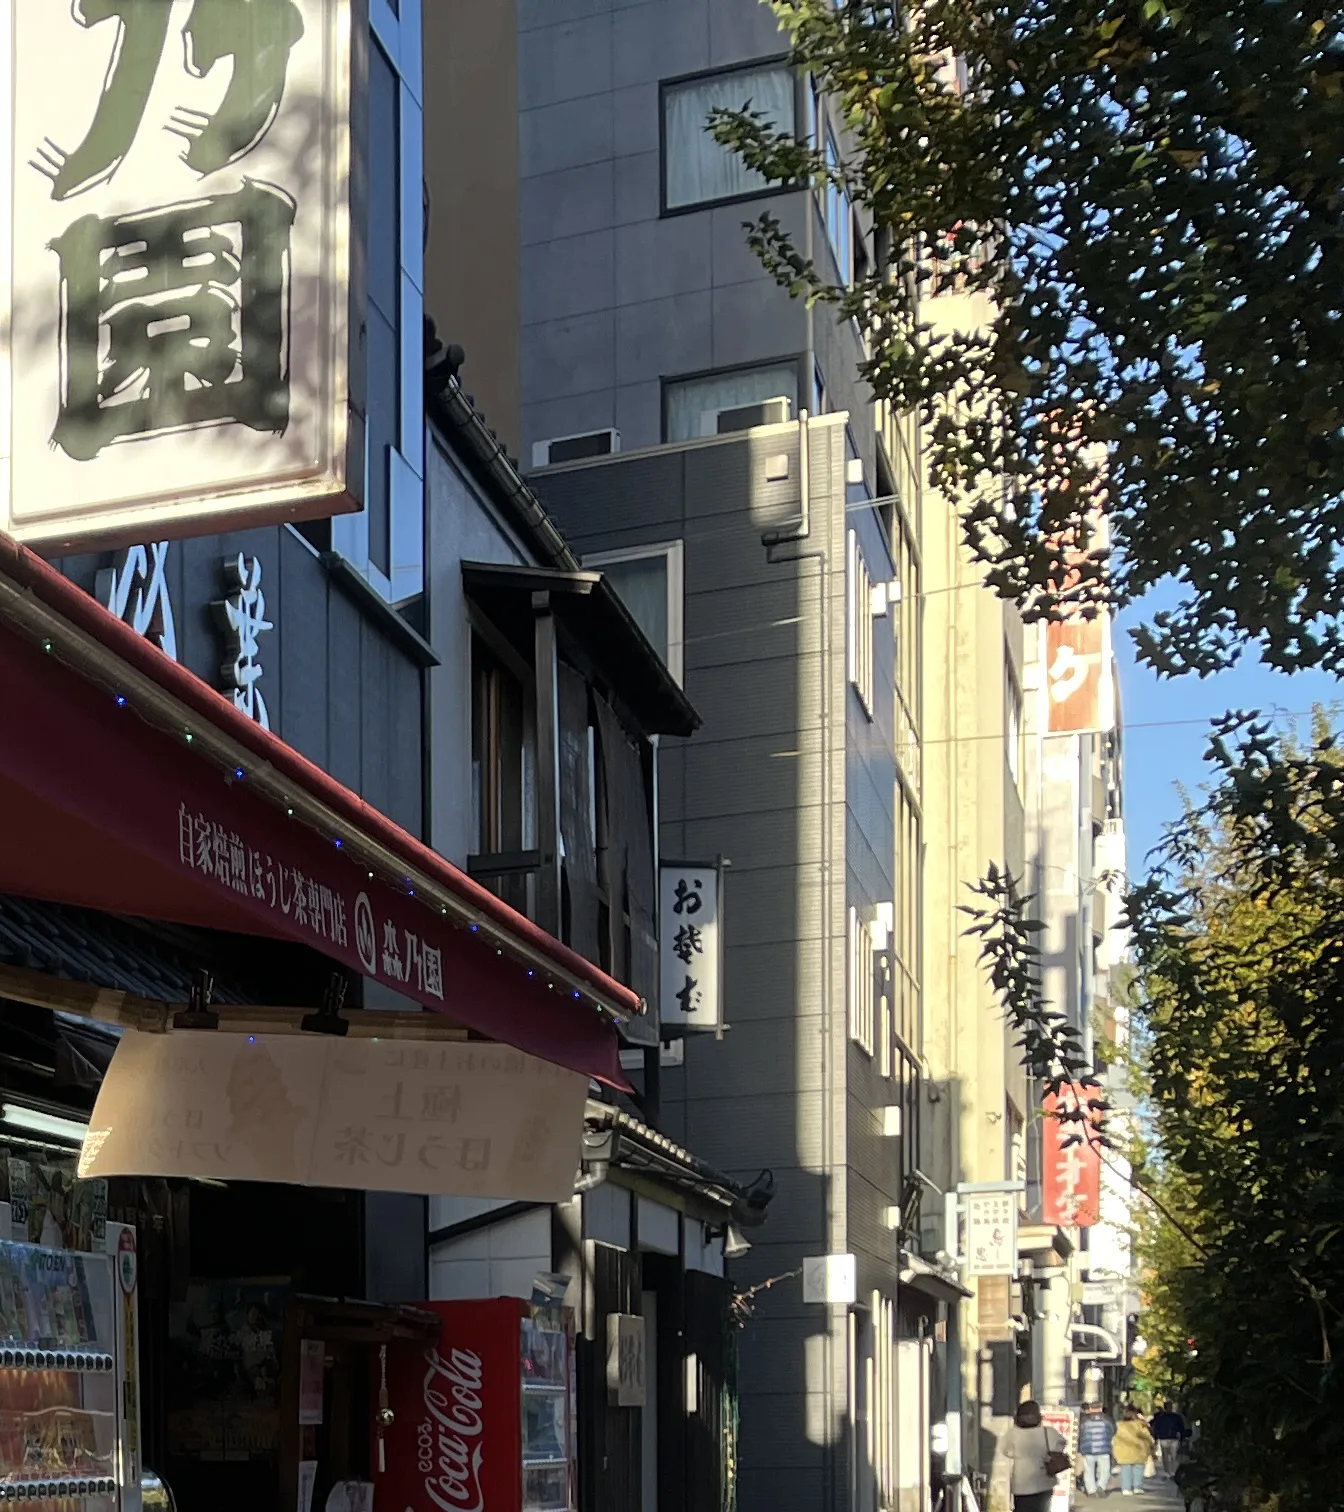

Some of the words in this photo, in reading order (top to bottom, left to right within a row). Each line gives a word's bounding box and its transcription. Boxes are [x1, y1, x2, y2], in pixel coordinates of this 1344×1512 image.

[178, 801, 348, 948] 自家焙煎ほうじ茶専門店
[382, 918, 444, 1001] 森乃園
